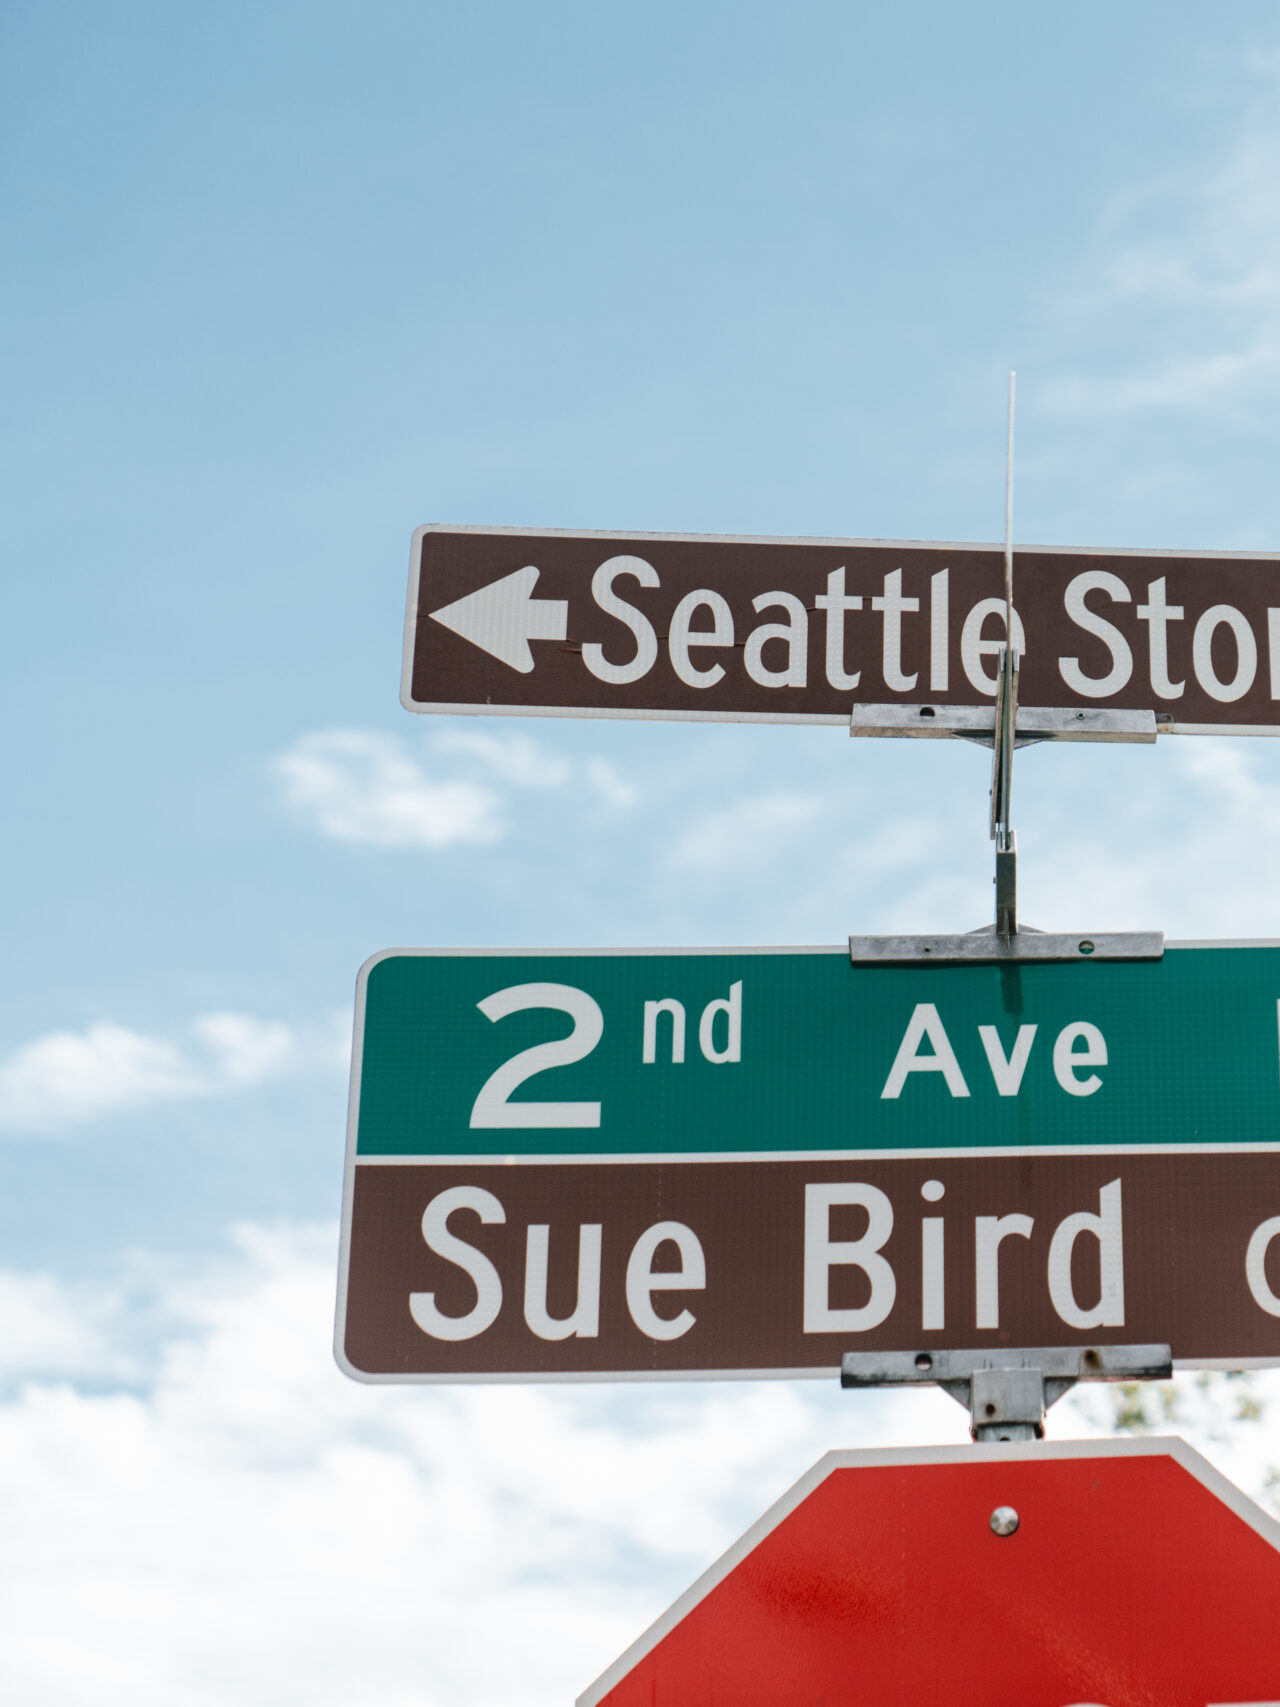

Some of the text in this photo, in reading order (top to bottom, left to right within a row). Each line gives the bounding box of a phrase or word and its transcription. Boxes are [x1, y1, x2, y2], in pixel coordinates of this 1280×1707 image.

[581, 554, 1026, 697] Seattle
[469, 980, 742, 1129] 2nd
[880, 1003, 1109, 1100] Ave
[408, 1185, 706, 1342] Sue
[803, 1177, 1126, 1334] Bird
